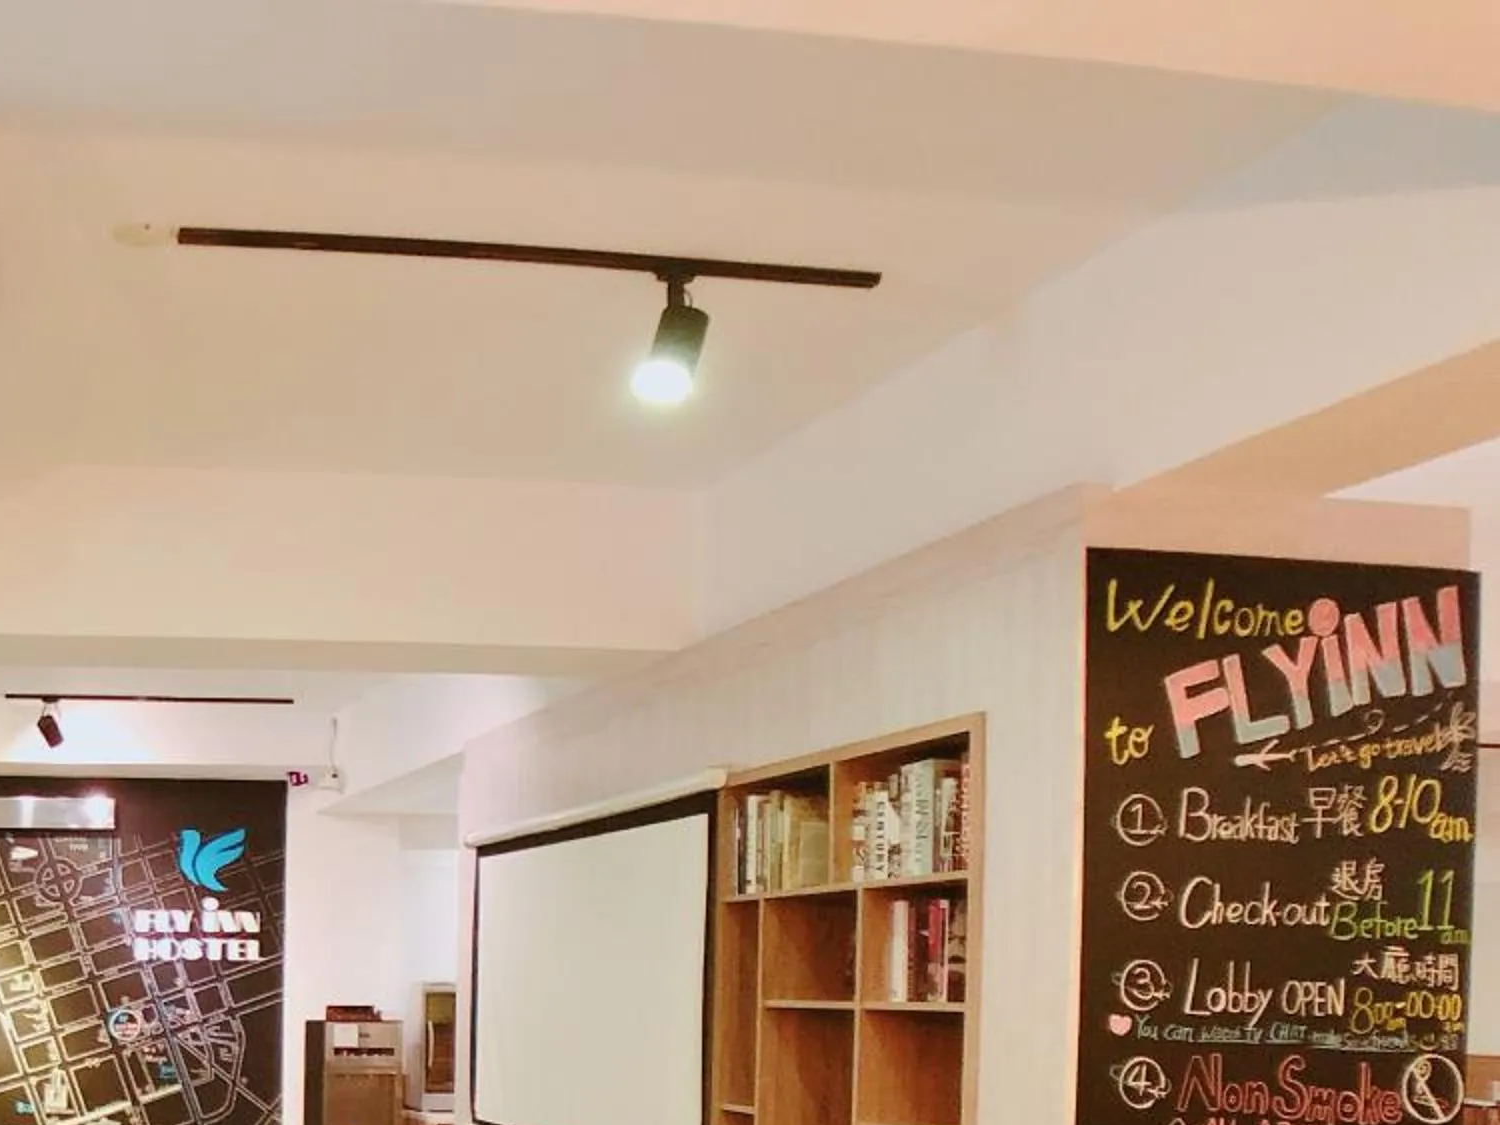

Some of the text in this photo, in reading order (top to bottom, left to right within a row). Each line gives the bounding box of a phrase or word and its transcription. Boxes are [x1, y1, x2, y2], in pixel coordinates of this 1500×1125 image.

[1106, 577, 1304, 639] Welcome
[1104, 716, 1155, 765] to
[1178, 786, 1300, 843] Breakfast
[1301, 784, 1367, 839] 早餐
[1329, 901, 1418, 941] Before
[1417, 869, 1456, 931] 11
[1330, 856, 1387, 901] 退房
[133, 937, 261, 960] HOSTEL
[1183, 957, 1273, 1030] Lobby
[1280, 977, 1345, 1017] OPEN
[1136, 1013, 1159, 1041] You
[1176, 1053, 1269, 1115] Non
